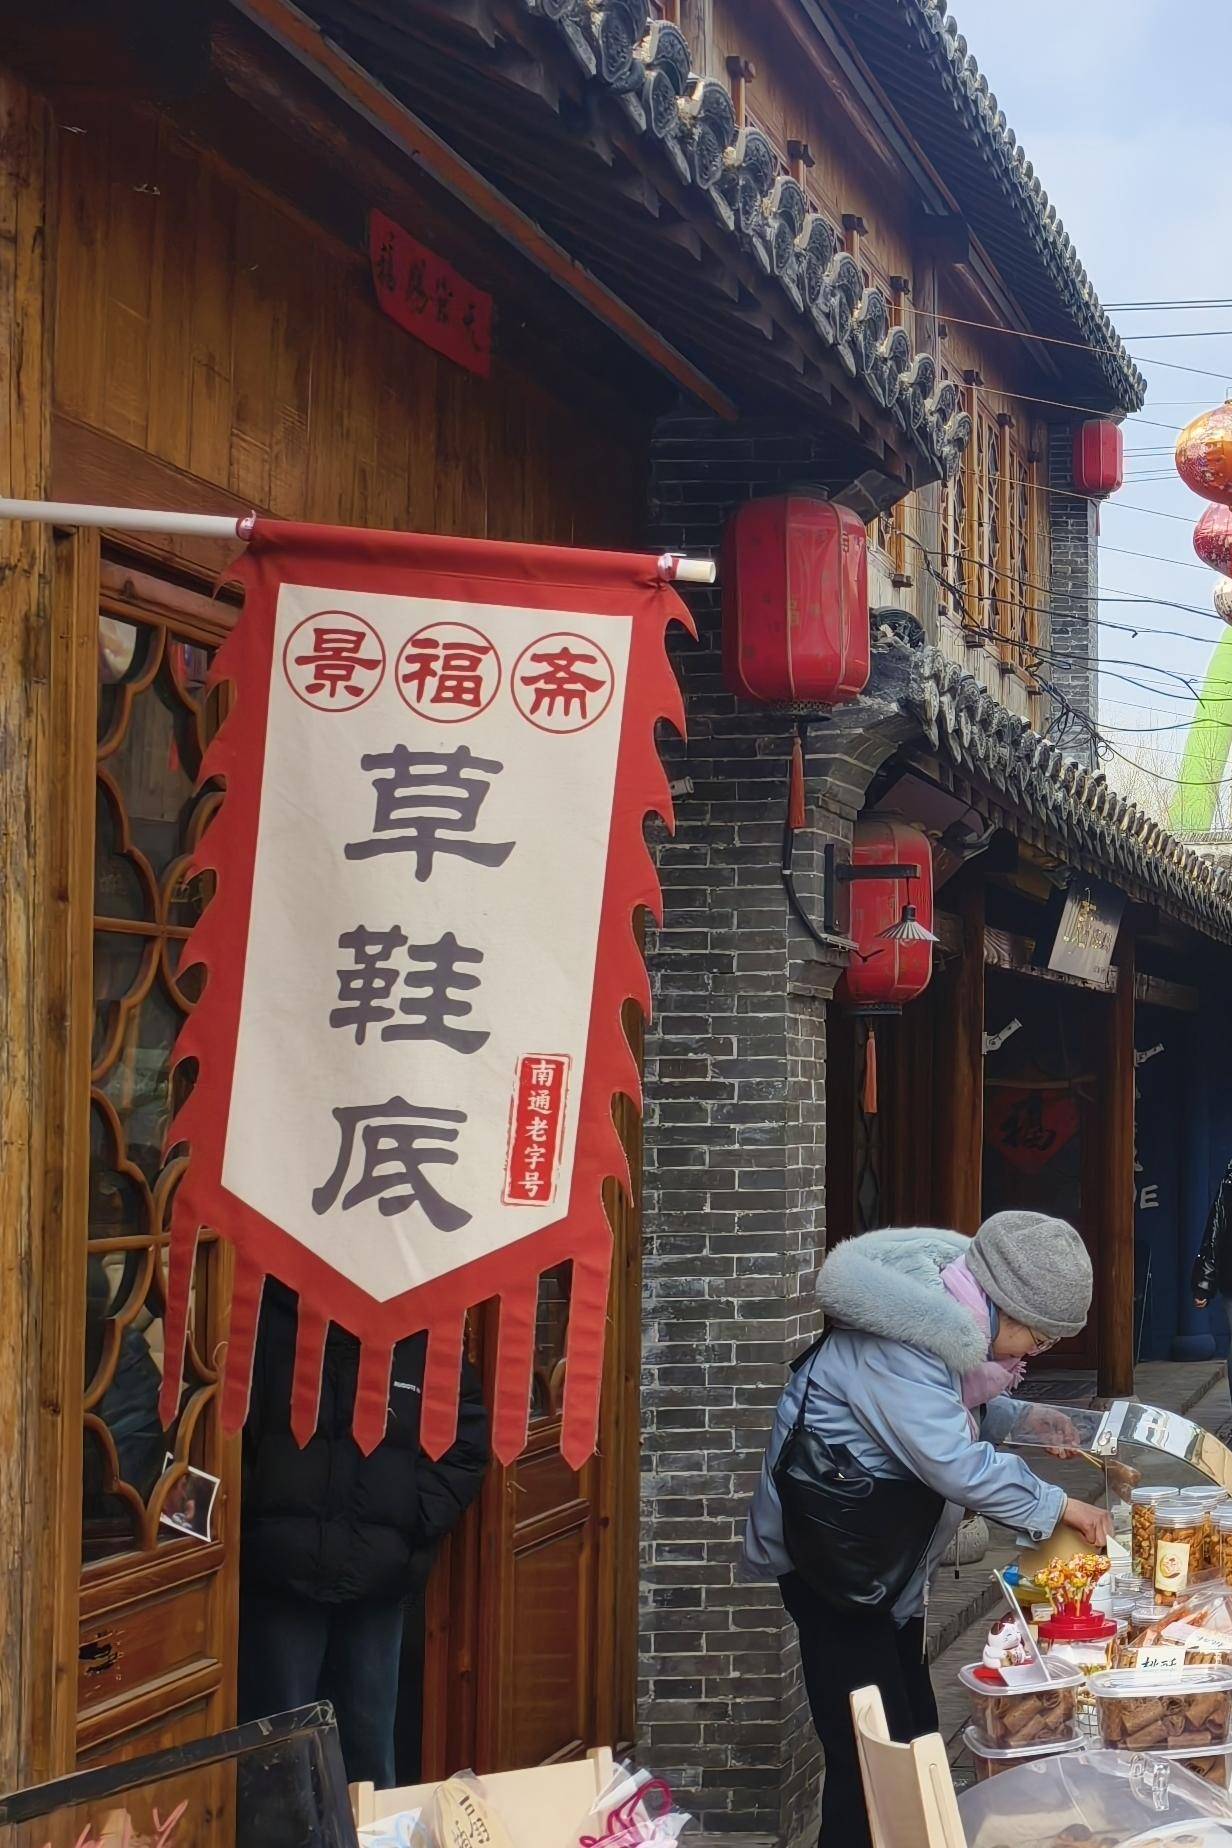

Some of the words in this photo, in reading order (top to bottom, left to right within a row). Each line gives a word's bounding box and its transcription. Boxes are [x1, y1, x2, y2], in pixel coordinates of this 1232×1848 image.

[294, 626, 607, 721] 景福斋
[311, 743, 516, 1232] 草鞋底
[517, 1059, 557, 1198] 南通老字号
[1001, 1089, 1058, 1151] 福
